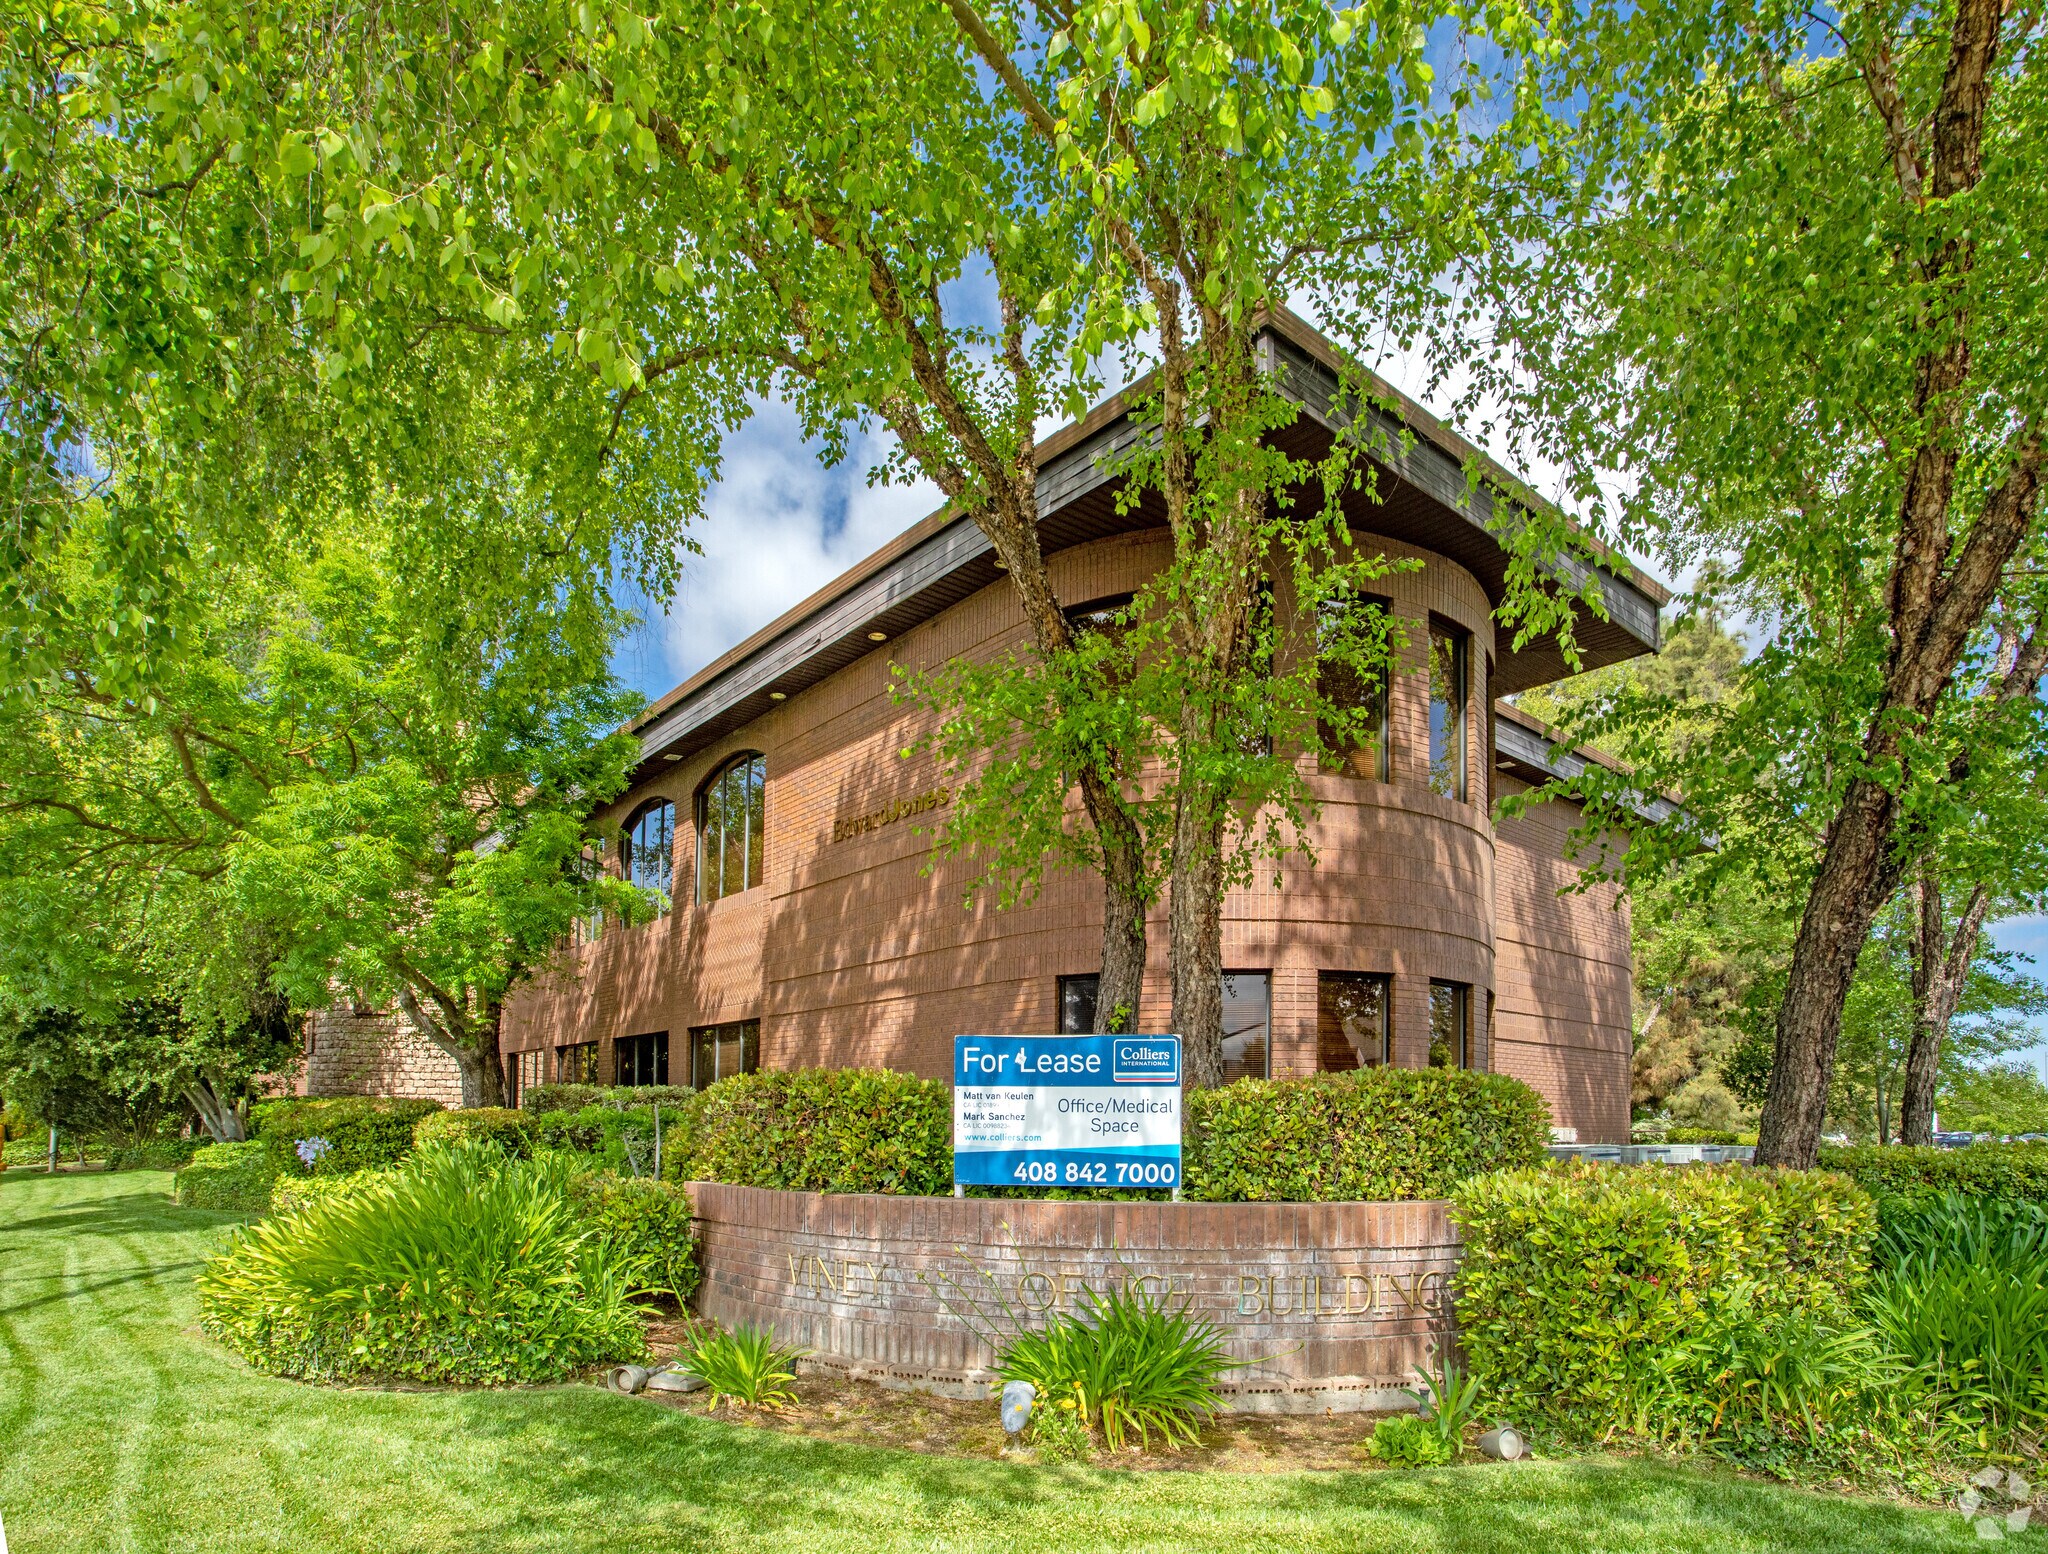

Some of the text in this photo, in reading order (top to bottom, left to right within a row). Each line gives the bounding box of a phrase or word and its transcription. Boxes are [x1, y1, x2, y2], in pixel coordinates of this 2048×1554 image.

[963, 1046, 1101, 1074] For Lease
[1120, 1046, 1170, 1060] Colliers
[963, 1091, 983, 1100] Matt
[1004, 1091, 1034, 1100] Keulen
[1057, 1097, 1173, 1115] Office/Medical
[963, 1112, 1026, 1121] Mark Sanchez
[1090, 1117, 1139, 1137] Space
[965, 1133, 1042, 1142] www.colliers.com
[1014, 1161, 1175, 1184] 408 842 7000
[1237, 1270, 1444, 1316] BUILDING
